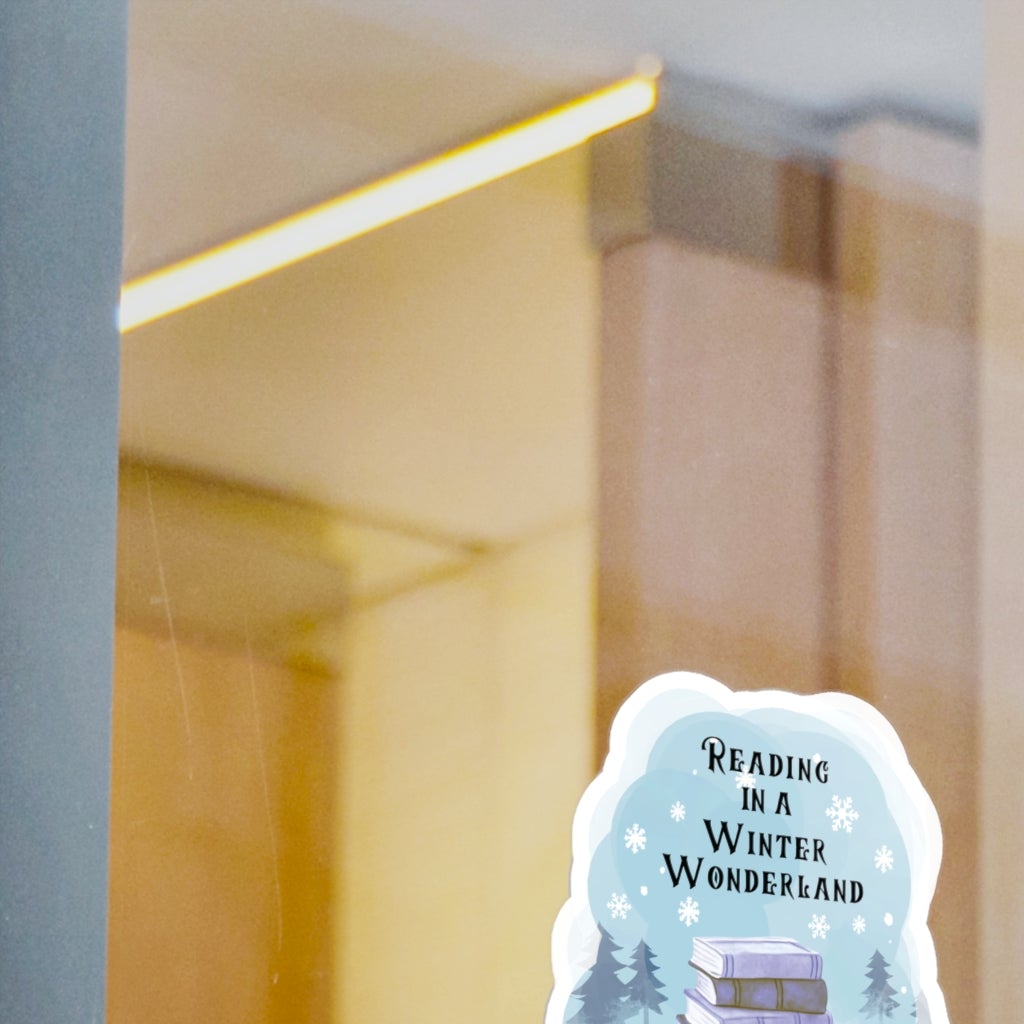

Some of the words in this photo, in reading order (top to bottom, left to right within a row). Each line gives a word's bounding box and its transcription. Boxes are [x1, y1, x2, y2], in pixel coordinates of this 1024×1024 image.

[701, 736, 829, 784] READING
[741, 786, 765, 814] IN
[775, 791, 792, 816] A
[703, 818, 827, 865] WINTER
[662, 853, 864, 904] WONDERLAND
